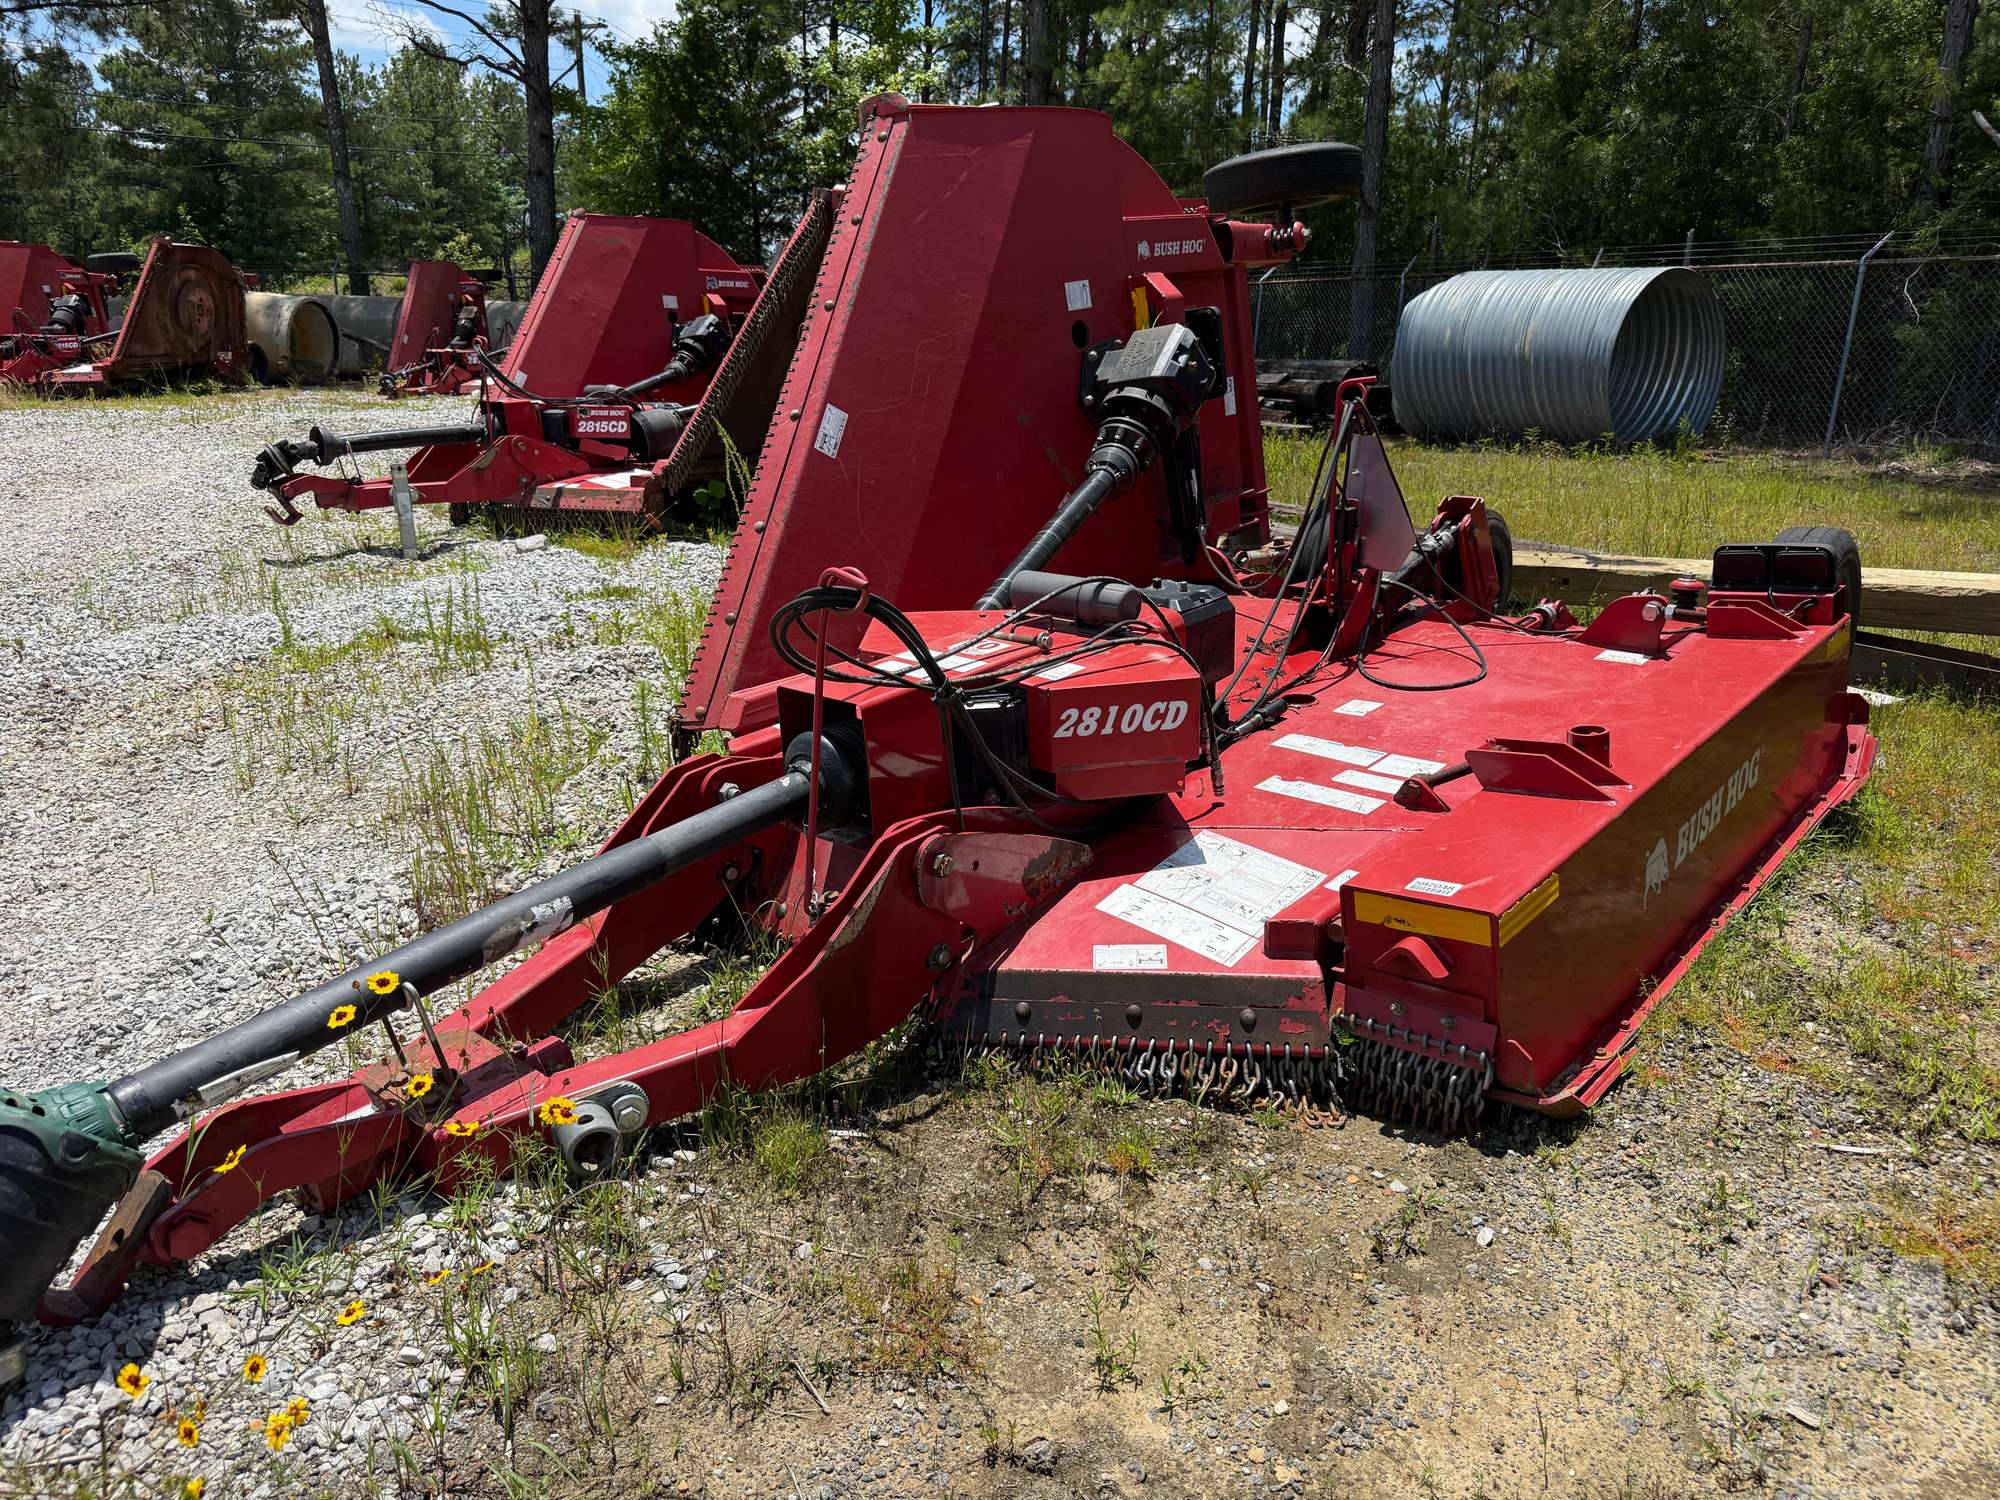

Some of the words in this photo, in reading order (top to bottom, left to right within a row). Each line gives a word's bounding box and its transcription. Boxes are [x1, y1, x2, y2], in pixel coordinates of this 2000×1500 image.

[1154, 241, 1180, 257] BUSH
[1182, 239, 1203, 254] HOG
[718, 280, 734, 288] BUSH
[590, 409, 608, 417] BUSH
[577, 420, 628, 433] 2815CD
[1053, 700, 1189, 738] 2810CD
[1674, 784, 1725, 870] BUSH
[1724, 747, 1761, 817] HOG
